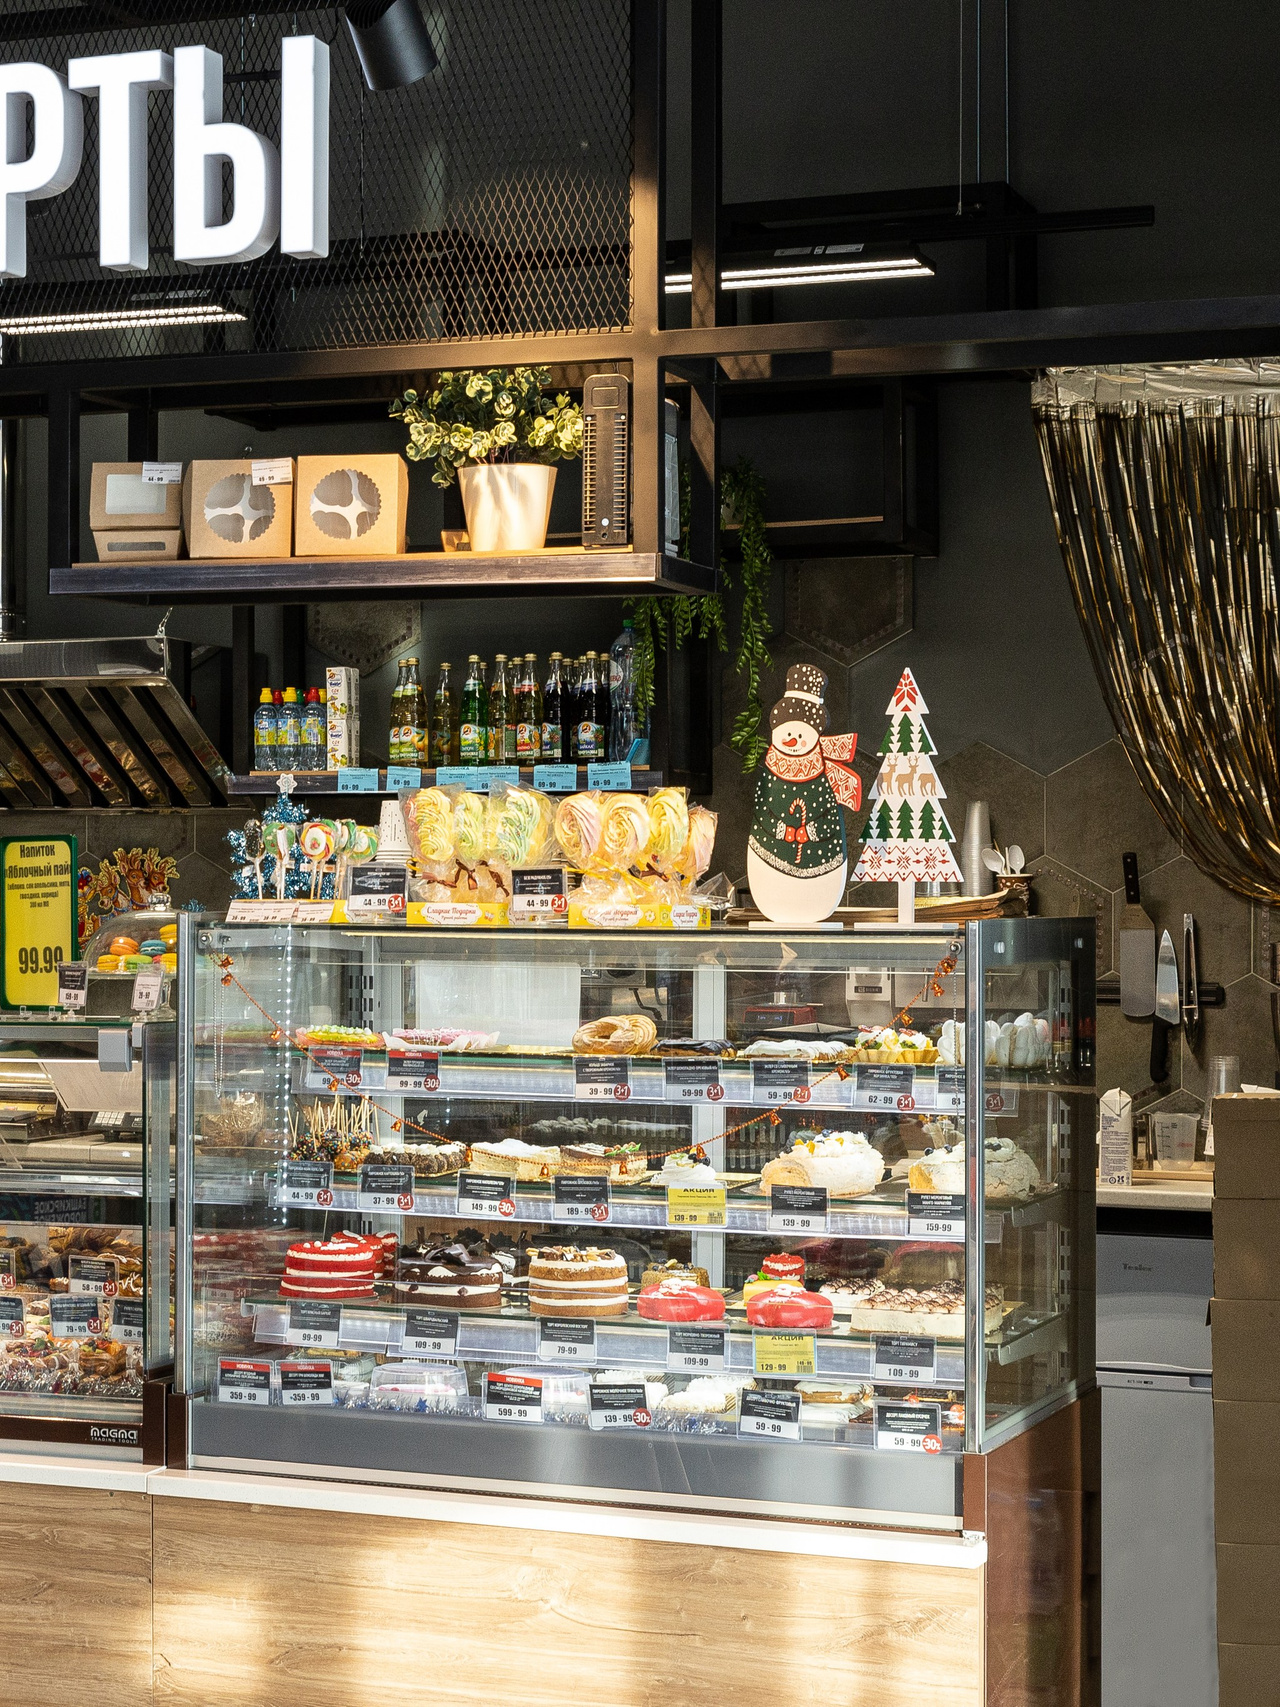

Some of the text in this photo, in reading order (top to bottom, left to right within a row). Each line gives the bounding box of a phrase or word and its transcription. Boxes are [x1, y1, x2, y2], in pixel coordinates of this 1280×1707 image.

[20, 844, 55, 858] Напиток
[526, 899, 549, 908] 44-99
[553, 896, 566, 908] 3+1
[426, 906, 476, 916] Сладкие Подарки
[18, 946, 64, 974] 99.99
[400, 1080, 422, 1088] 99-99
[589, 1087, 612, 1095] 39-99
[615, 1086, 628, 1097] 3+1
[708, 1087, 722, 1098] 3+1
[868, 1095, 893, 1104] 62-99
[899, 1098, 912, 1108] 3+1
[318, 1191, 331, 1202] 3+1
[398, 1196, 411, 1206] 3+1
[472, 1203, 497, 1212] 149-99
[567, 1207, 593, 1215] 189-99
[674, 1214, 697, 1222] 139-99
[782, 1218, 810, 1227] 139-99
[926, 1223, 952, 1232] 159-99
[82, 1284, 102, 1292] 58-99
[105, 1283, 115, 1293] 3+1
[12, 1324, 22, 1333] 3+1
[89, 1320, 100, 1330] 3+1
[302, 1333, 322, 1342] 99-99
[415, 1341, 441, 1350] 109-99
[557, 1346, 577, 1354] 79-99
[684, 1357, 709, 1366] 109-99
[888, 1368, 919, 1378] 109-99
[230, 1391, 256, 1401] 359-99
[293, 1393, 320, 1401] 359-99
[498, 1408, 527, 1417] 599-99
[604, 1414, 633, 1423] 139-99
[755, 1422, 781, 1433] 59-99
[895, 1437, 921, 1447] 59-99
